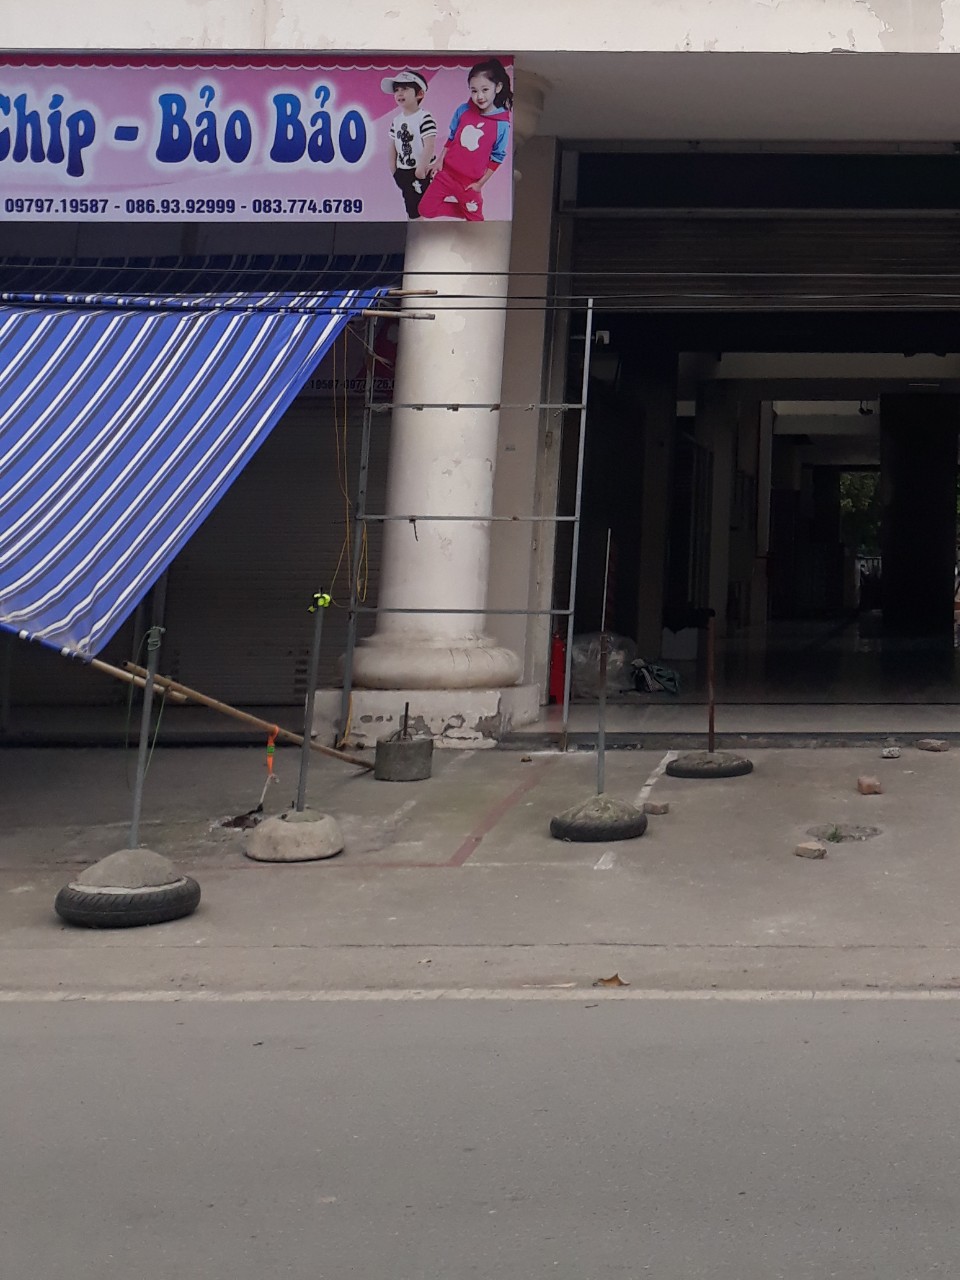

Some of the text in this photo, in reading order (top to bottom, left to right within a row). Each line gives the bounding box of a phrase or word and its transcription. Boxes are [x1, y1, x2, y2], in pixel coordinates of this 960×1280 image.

[155, 85, 252, 164] Bảo
[269, 85, 367, 164] Bảo
[5, 198, 109, 214] 09797.19587
[125, 198, 236, 214] 086.93.92999
[252, 198, 363, 214] 083.774.6789
